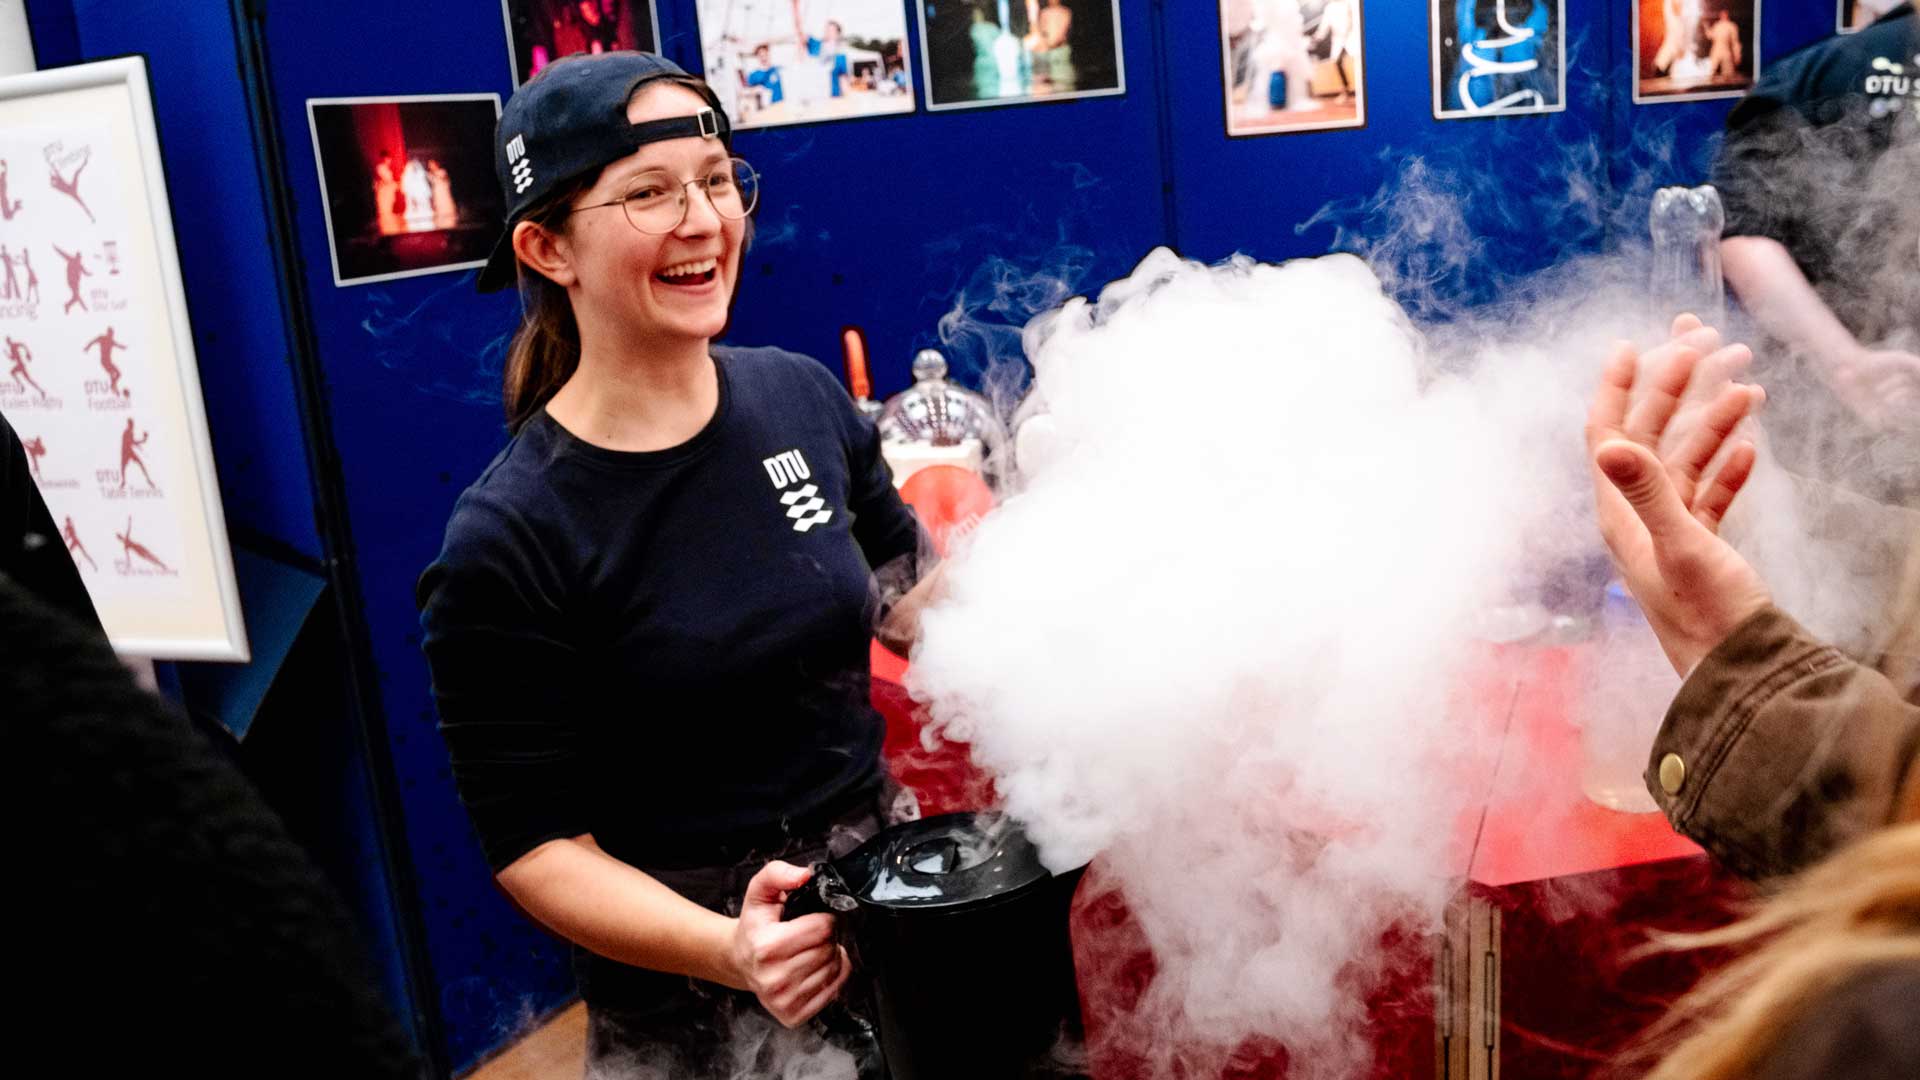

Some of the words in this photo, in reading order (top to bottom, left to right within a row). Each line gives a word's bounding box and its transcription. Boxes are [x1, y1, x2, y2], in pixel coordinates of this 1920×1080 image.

[1865, 75, 1910, 95] DTU
[506, 133, 526, 165] DTU
[84, 380, 109, 395] DTU
[96, 469, 120, 483] DTU
[762, 449, 811, 490] DTU
